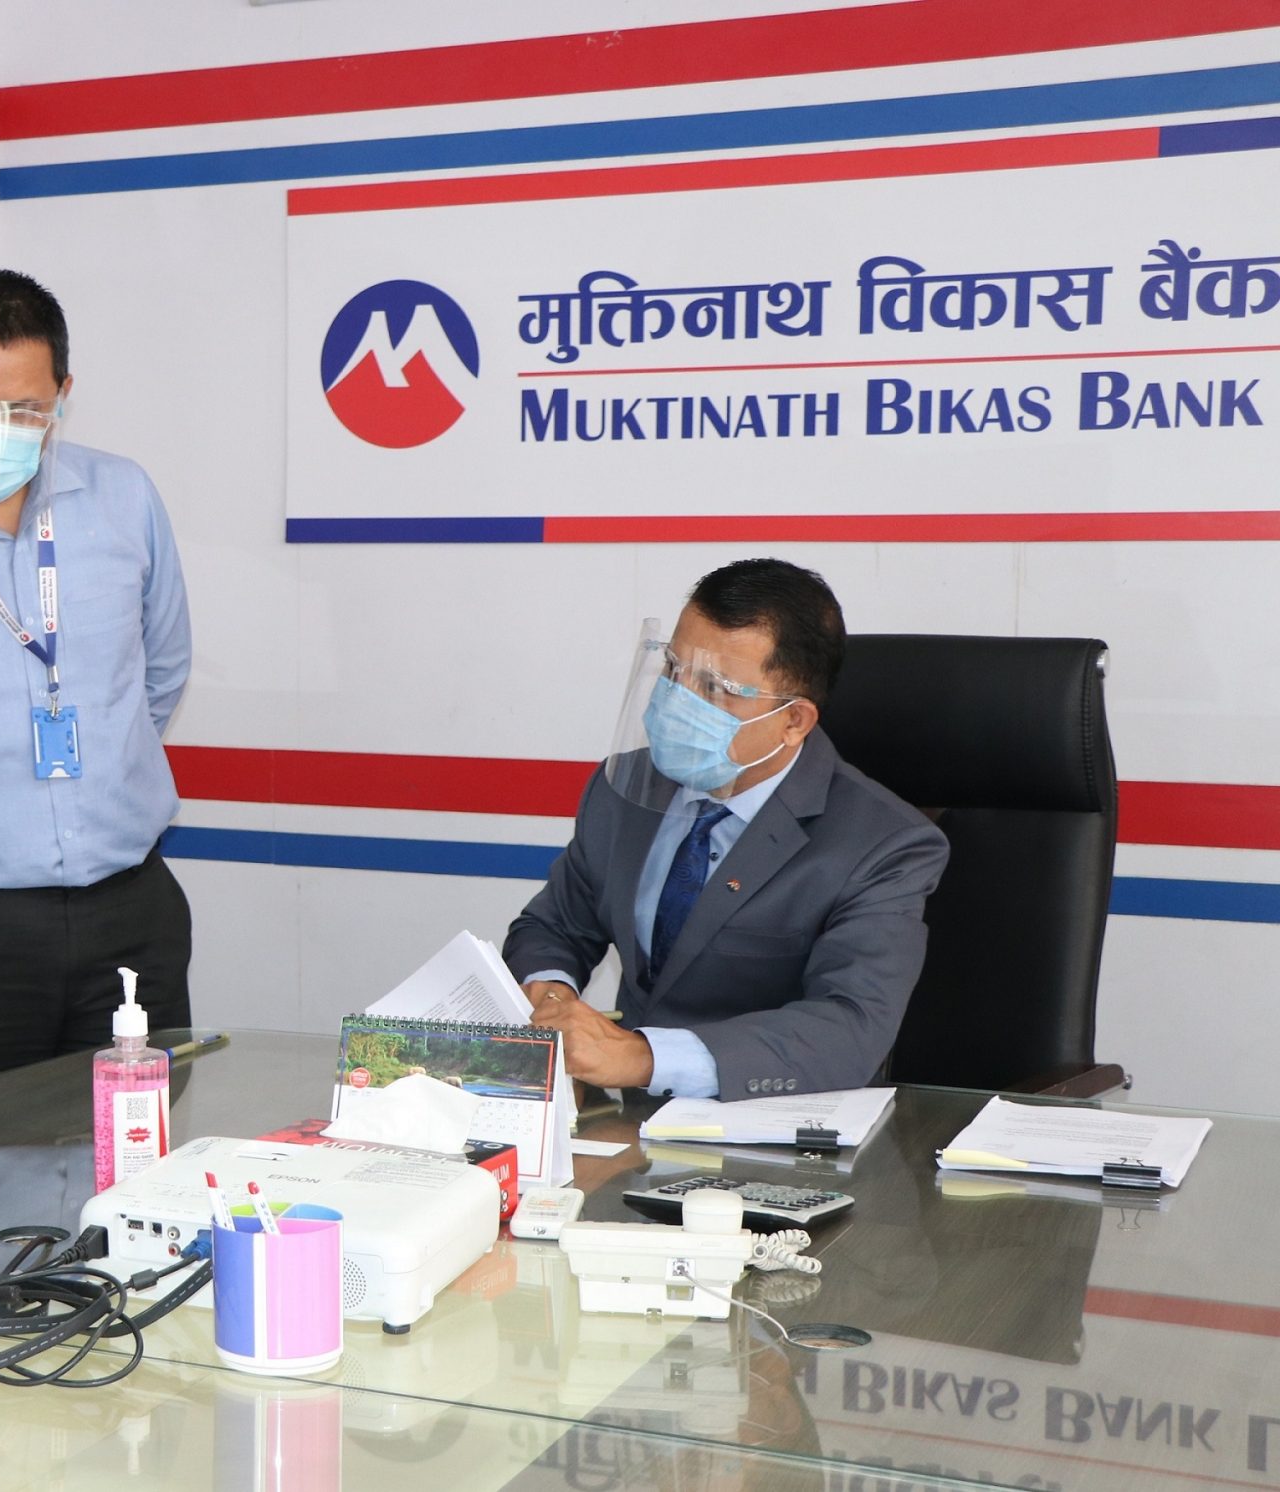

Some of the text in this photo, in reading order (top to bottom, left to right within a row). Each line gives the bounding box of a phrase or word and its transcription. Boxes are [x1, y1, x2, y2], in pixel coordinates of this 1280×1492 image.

[518, 270, 832, 364] मुक्तिनाथ
[857, 256, 1113, 334] विकास
[521, 371, 1263, 442] MUKTINATH BIKAS BANK
[267, 1174, 321, 1184] EPSON
